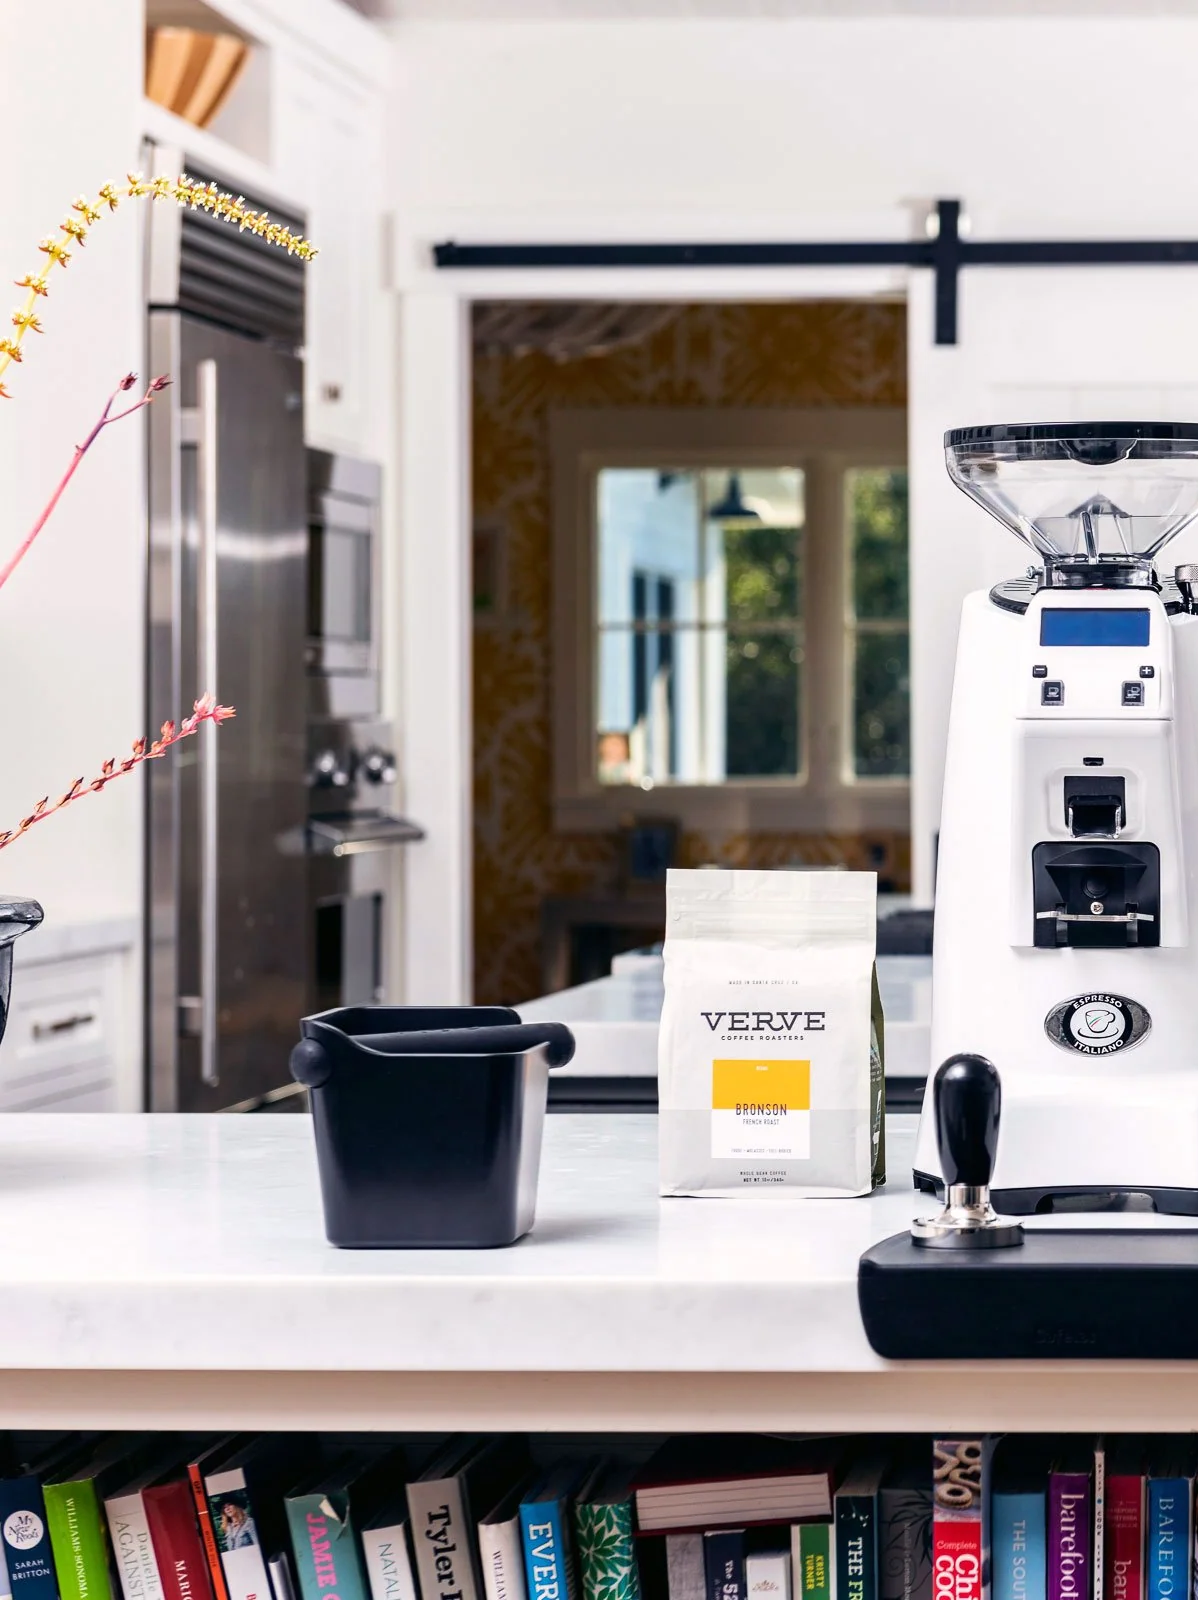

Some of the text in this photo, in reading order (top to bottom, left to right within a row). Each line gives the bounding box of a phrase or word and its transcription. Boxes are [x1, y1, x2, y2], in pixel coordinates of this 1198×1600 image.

[1073, 995, 1123, 1010] ESPRESSO
[701, 1012, 826, 1031] VERVE
[1074, 1040, 1123, 1054] ITALIANO
[736, 1103, 787, 1116] BRONSON
[306, 1513, 337, 1589] JAMIE
[425, 1504, 457, 1586] Tyler
[936, 1541, 977, 1551] Complete
[1013, 1519, 1026, 1553] THE
[1060, 1493, 1085, 1600] barefoot
[1158, 1498, 1175, 1600] BAREFO
[15, 1559, 44, 1570] SARAH
[115, 1520, 146, 1600] AGAINST
[378, 1543, 402, 1600] NATAL
[529, 1521, 560, 1600] EVER
[725, 1560, 734, 1580] The
[806, 1554, 814, 1590] TURNER
[816, 1555, 824, 1588] KRISTY
[848, 1537, 863, 1576] THE
[12, 1568, 50, 1581] BRITTON
[1114, 1560, 1132, 1600] bar
